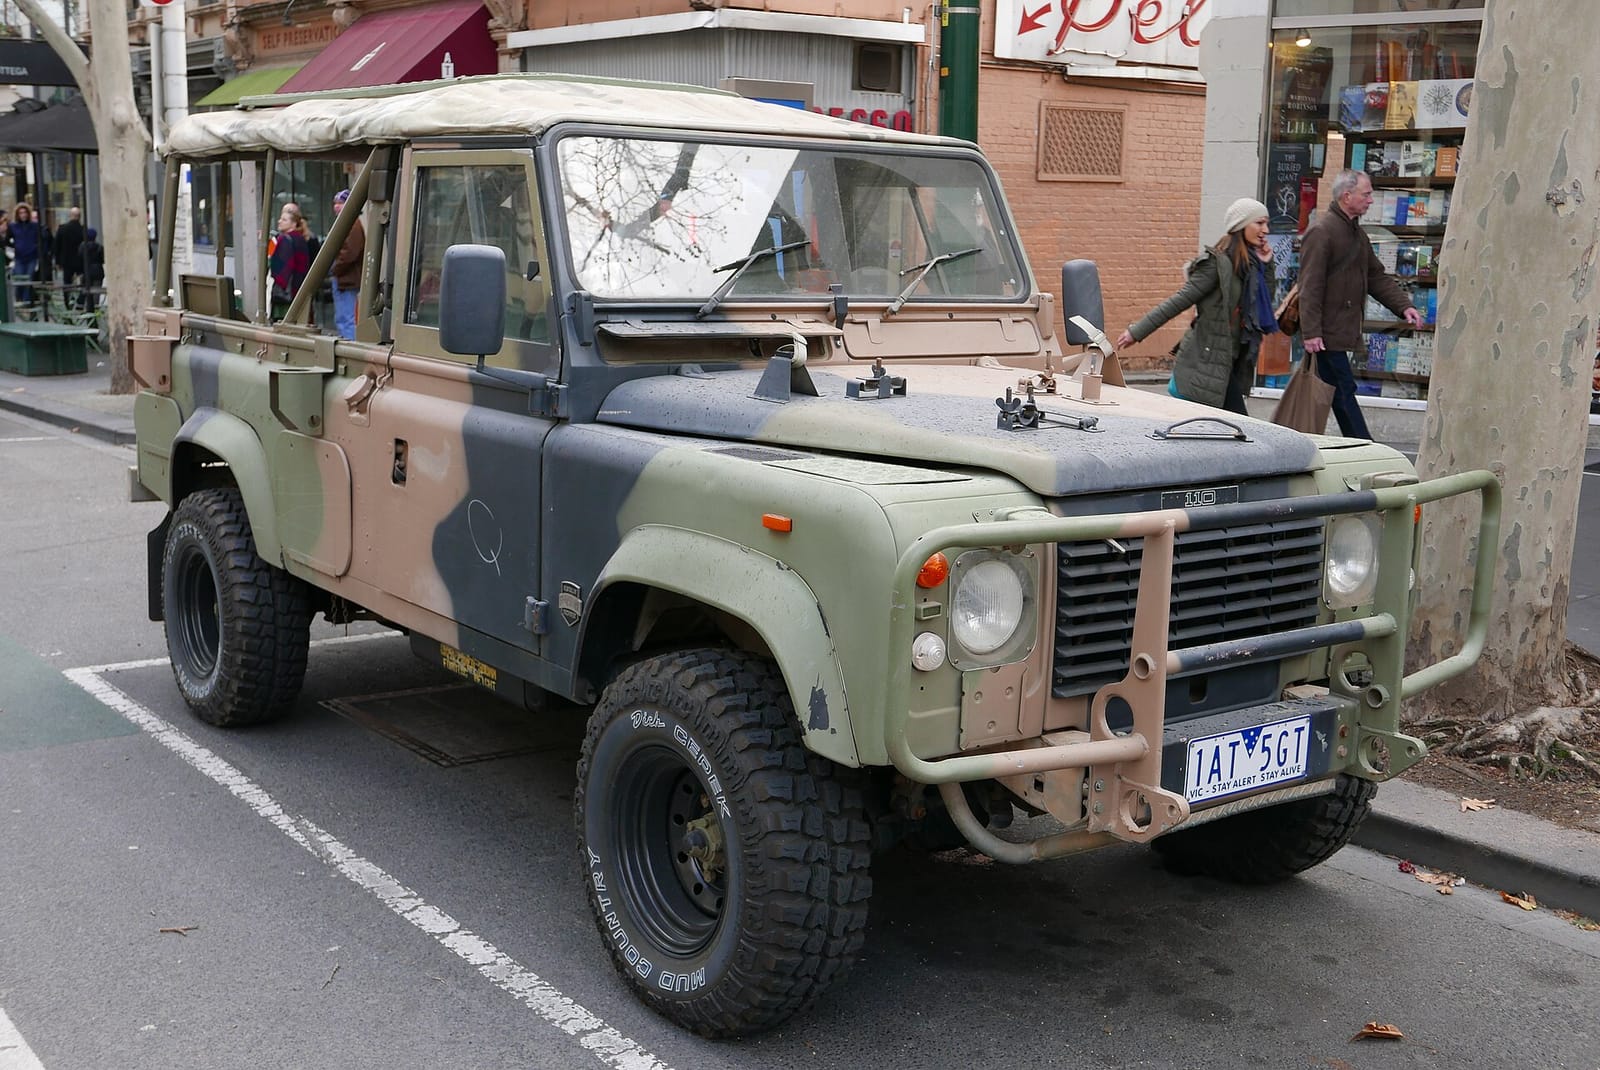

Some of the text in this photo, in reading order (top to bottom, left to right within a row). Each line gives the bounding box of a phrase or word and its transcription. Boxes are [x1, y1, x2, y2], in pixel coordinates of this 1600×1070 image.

[262, 33, 280, 50] SELF
[1286, 120, 1316, 134] LILA
[1184, 490, 1216, 507] 110
[630, 709, 732, 819] Dick CEPEK
[1196, 727, 1305, 787] 1AT 5GT
[1189, 787, 1204, 799] VIC
[1211, 781, 1233, 794] STAY
[1233, 775, 1257, 789] ALERT
[1260, 770, 1281, 782] STAY
[1281, 764, 1302, 777] ALIVE
[587, 845, 706, 992] MUD COUNTRY
